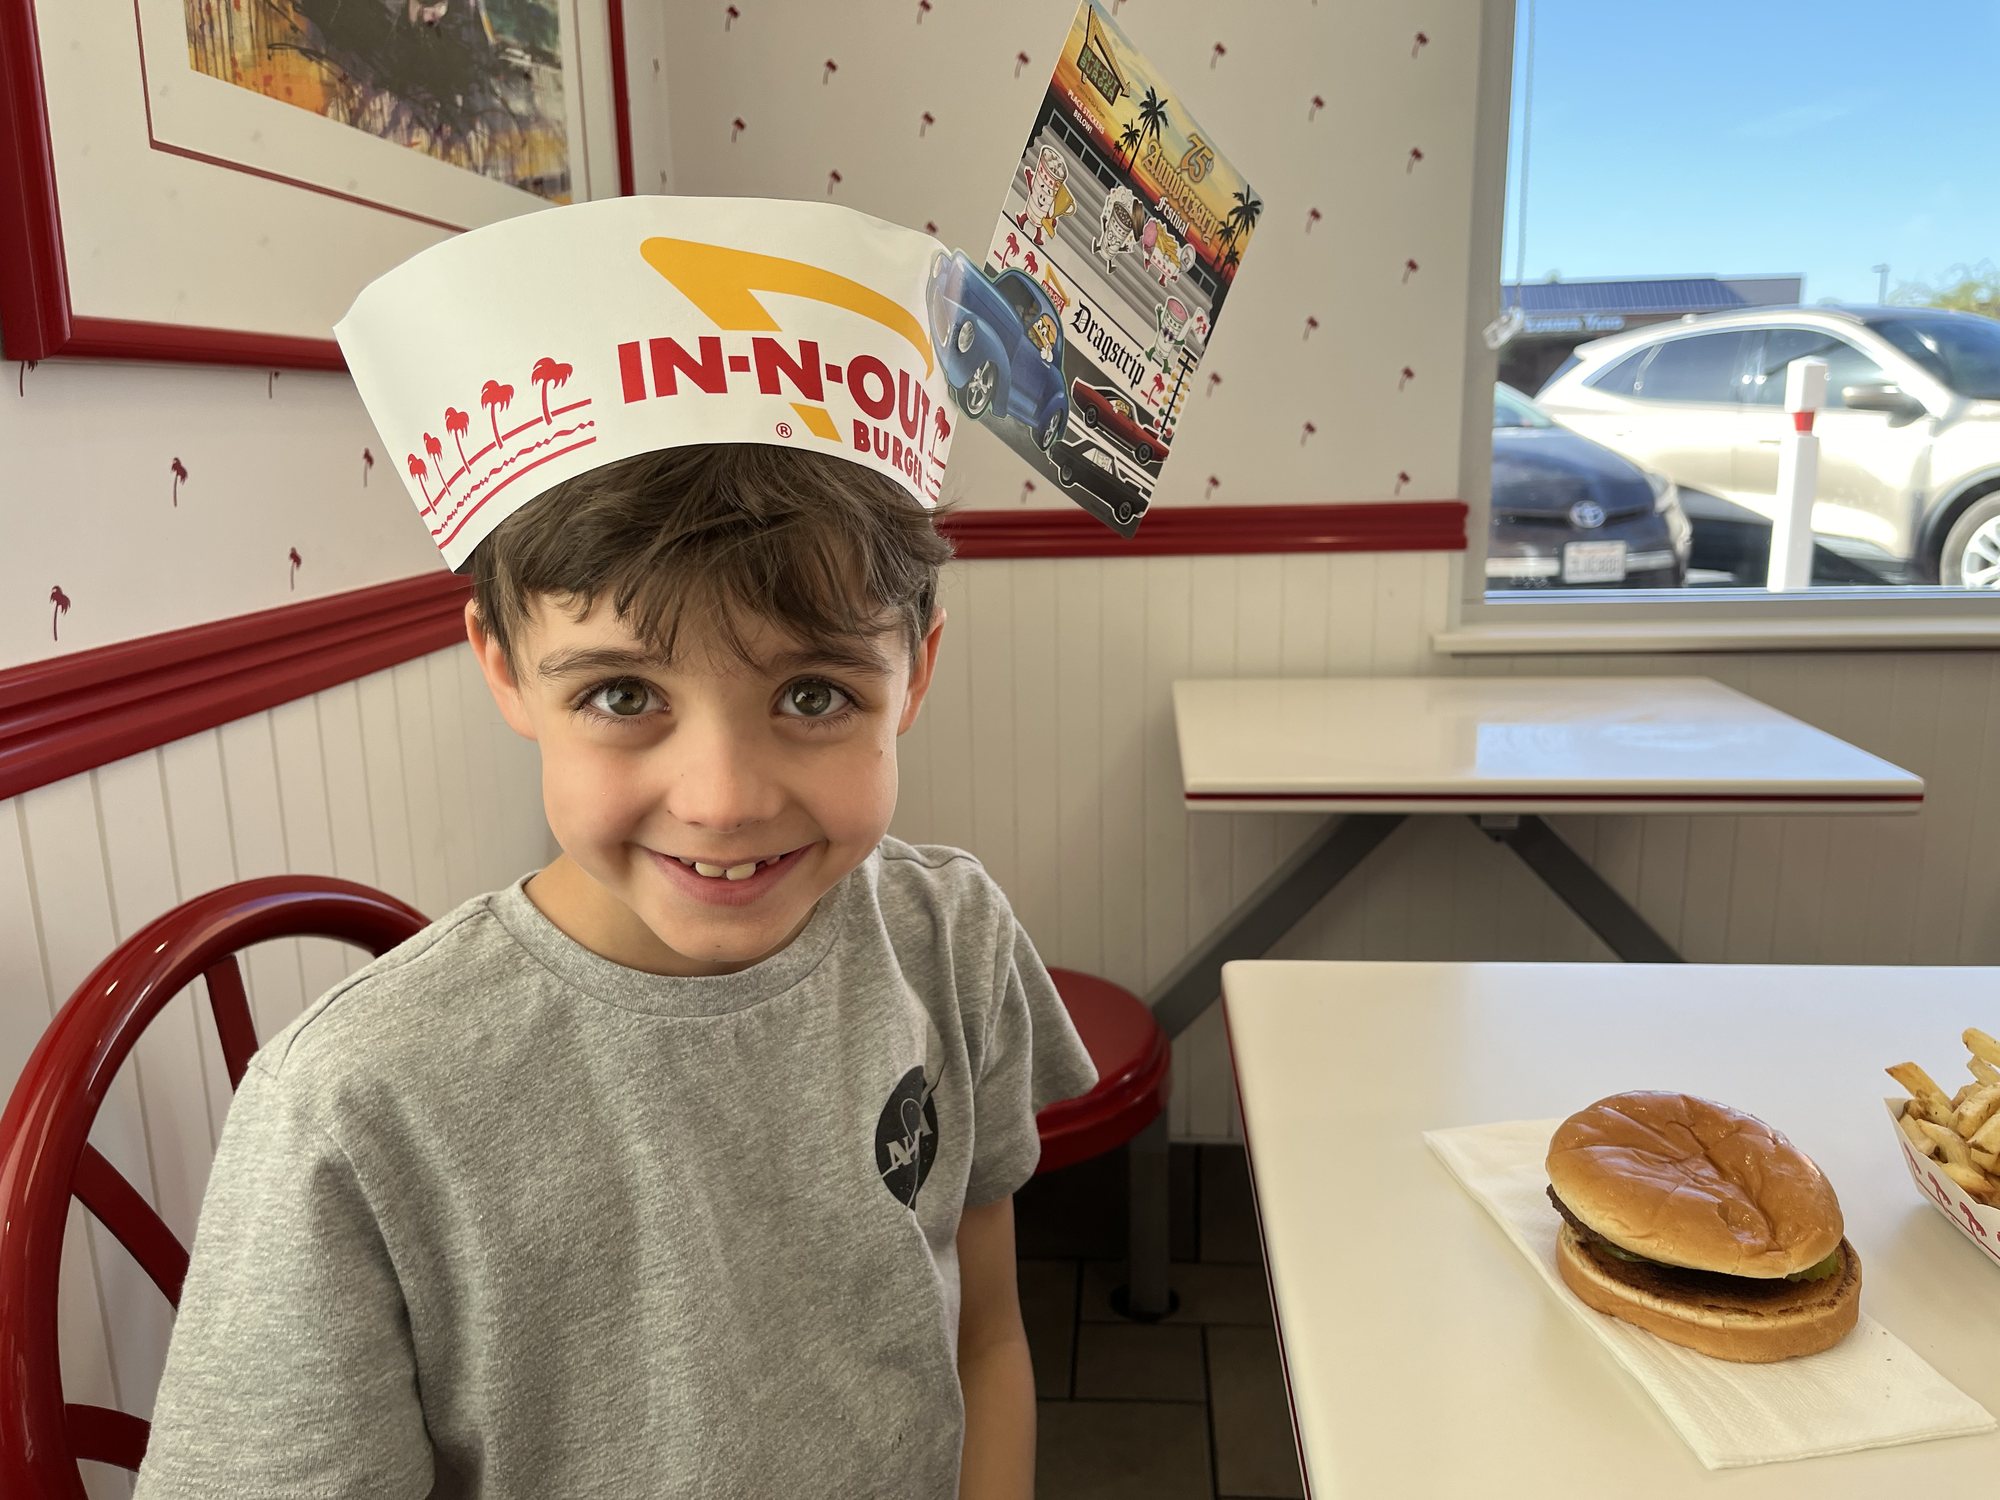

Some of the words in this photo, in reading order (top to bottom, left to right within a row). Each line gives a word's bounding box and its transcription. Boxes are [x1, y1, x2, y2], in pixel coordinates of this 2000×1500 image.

[1079, 56, 1115, 102] BURGER
[1083, 46, 1119, 91] IN-N-OUT
[1067, 89, 1084, 110] PLACE
[1082, 106, 1105, 134] STICKERS
[1072, 109, 1094, 134] BELOW!
[1142, 140, 1220, 247] Anniversary
[1154, 196, 1191, 238] Festival
[1070, 298, 1146, 391] Dragstrip
[617, 335, 931, 455] IN-N-OUT
[853, 418, 923, 493] BURGER
